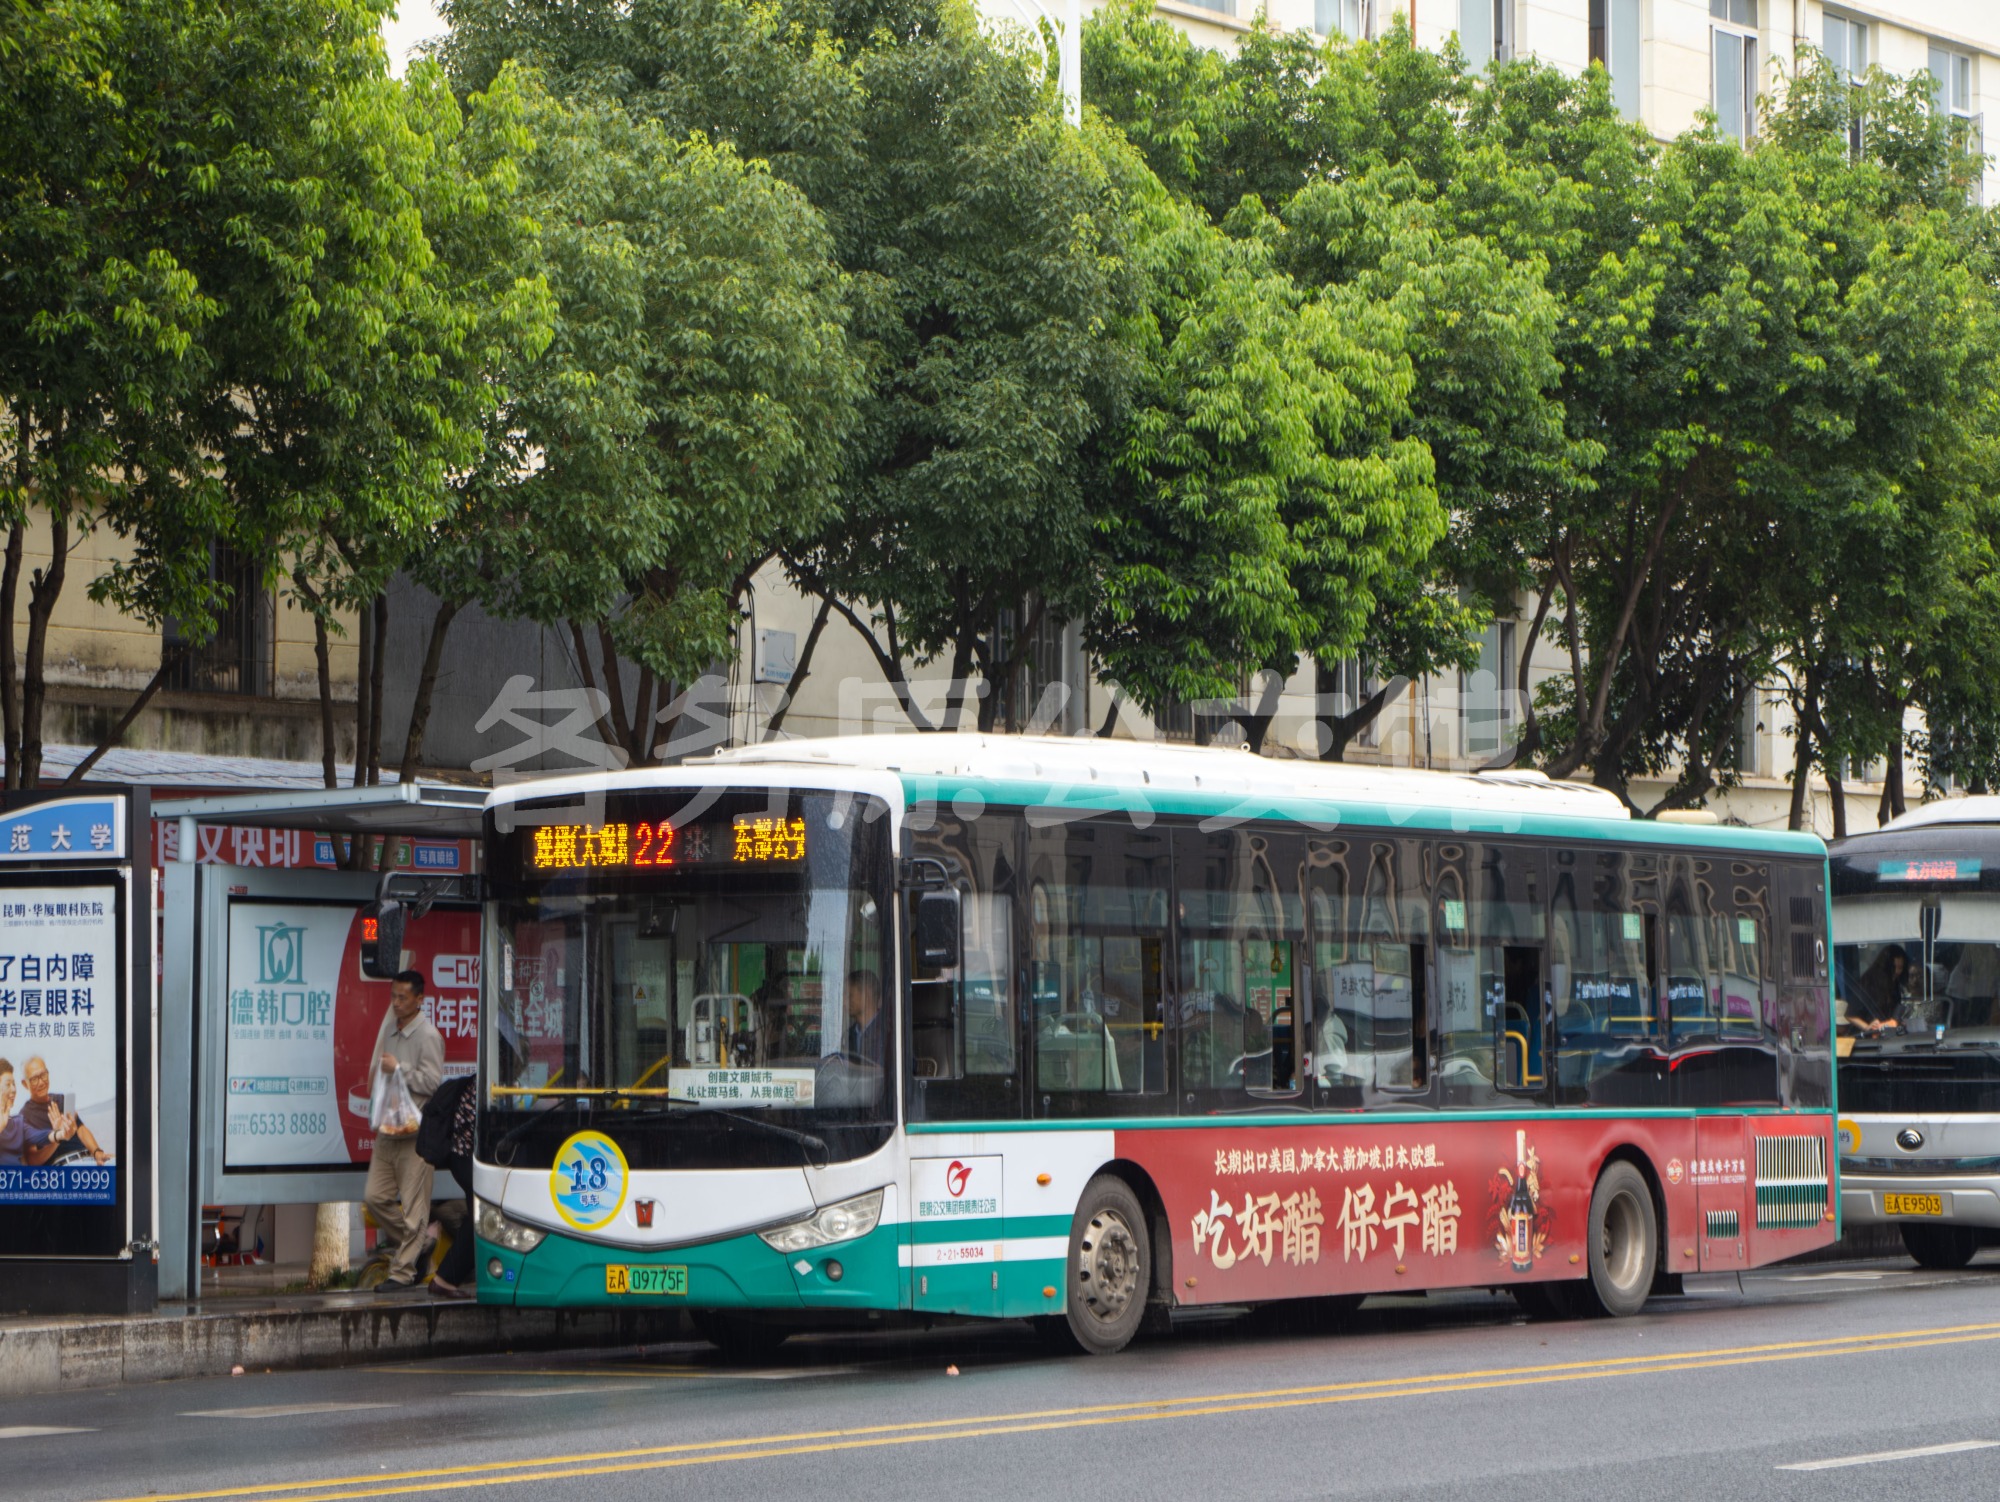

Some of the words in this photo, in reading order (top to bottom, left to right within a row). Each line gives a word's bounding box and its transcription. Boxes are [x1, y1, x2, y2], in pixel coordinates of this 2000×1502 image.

[10, 824, 111, 852] 范大学
[636, 823, 673, 864] 22
[362, 918, 378, 940] 22
[0, 988, 94, 1017] 华厦眼科
[231, 989, 331, 1026] 德韩口腔
[708, 1071, 773, 1084] 创建文明城市
[290, 1113, 327, 1135] 8888
[71, 1171, 110, 1190] 9999
[570, 1157, 608, 1193] 18
[580, 1195, 600, 1207] 号车
[919, 1199, 997, 1217] 昆明公交集团有限责任公司
[1191, 1186, 1325, 1270] 吃好醋
[1336, 1180, 1461, 1264] 保宁醋
